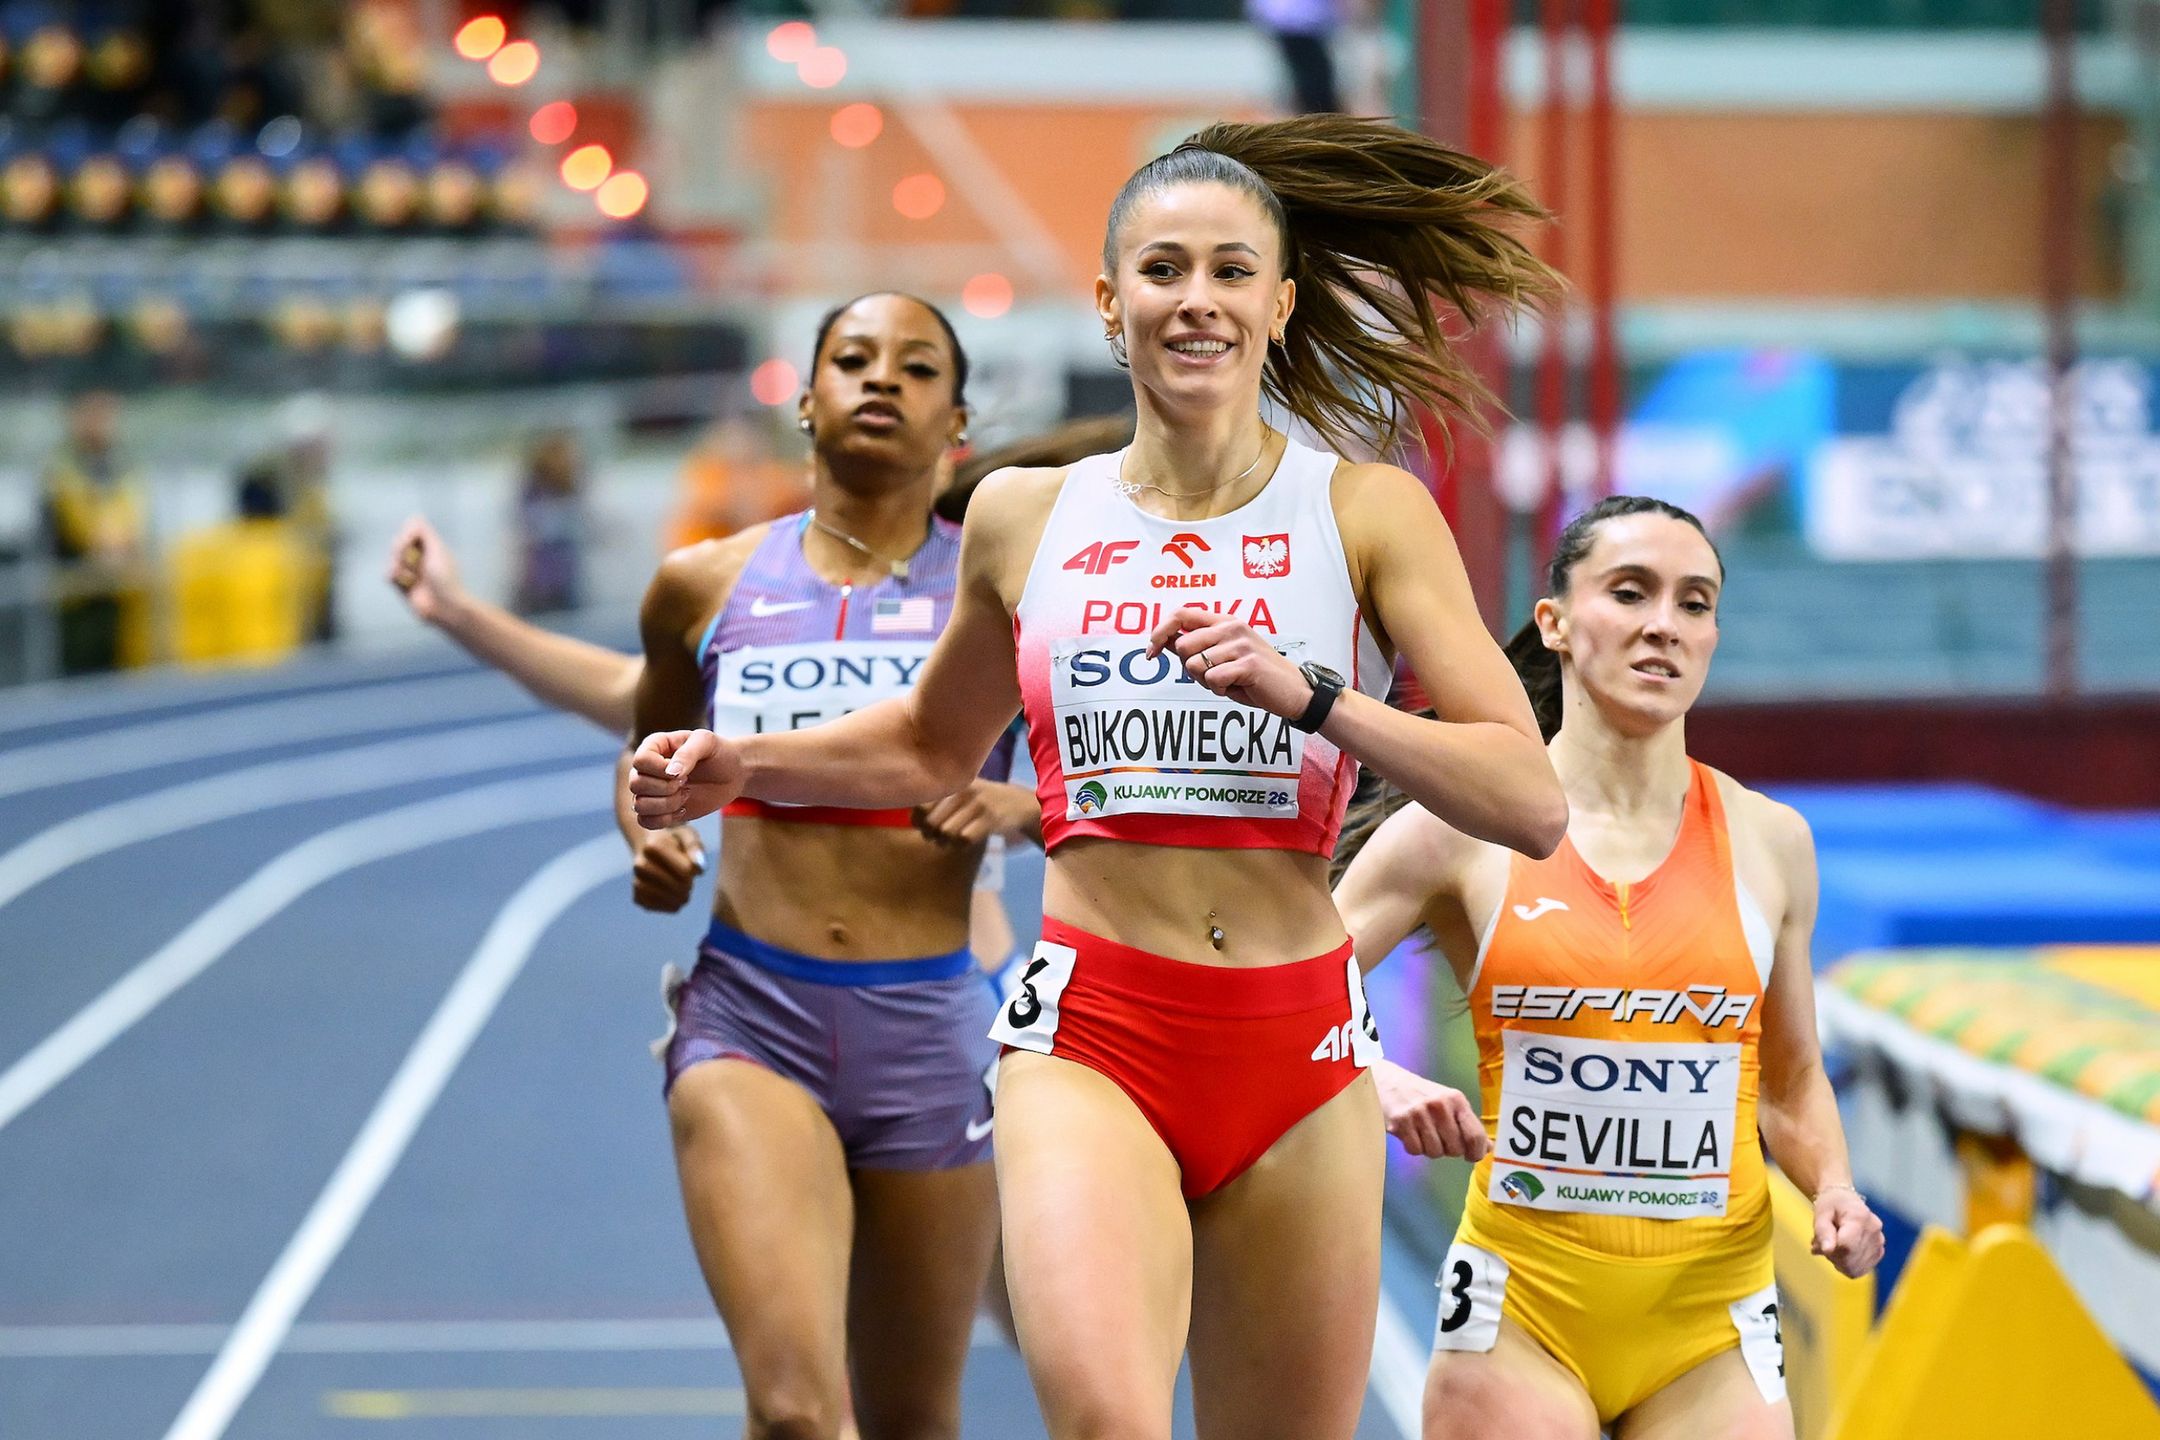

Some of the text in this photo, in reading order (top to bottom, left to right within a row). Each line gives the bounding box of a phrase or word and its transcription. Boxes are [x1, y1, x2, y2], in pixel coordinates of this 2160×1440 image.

[1062, 540, 1140, 575] 4F
[1151, 573, 1216, 588] ORLEN
[740, 656, 928, 694] SONY
[1070, 647, 1287, 688] SO
[1064, 709, 1294, 768] BUKOWIECKA
[1114, 785, 1289, 805] KUJAWY POMORZE 26
[1491, 983, 1757, 1029] ESPAÑA
[1524, 1046, 1720, 1093] SONY
[1509, 1105, 1719, 1169] SEVILLA
[1556, 1185, 1625, 1203] KUJAWY
[1628, 1189, 1699, 1206] POMORZE
[1440, 1260, 1474, 1333] 3
